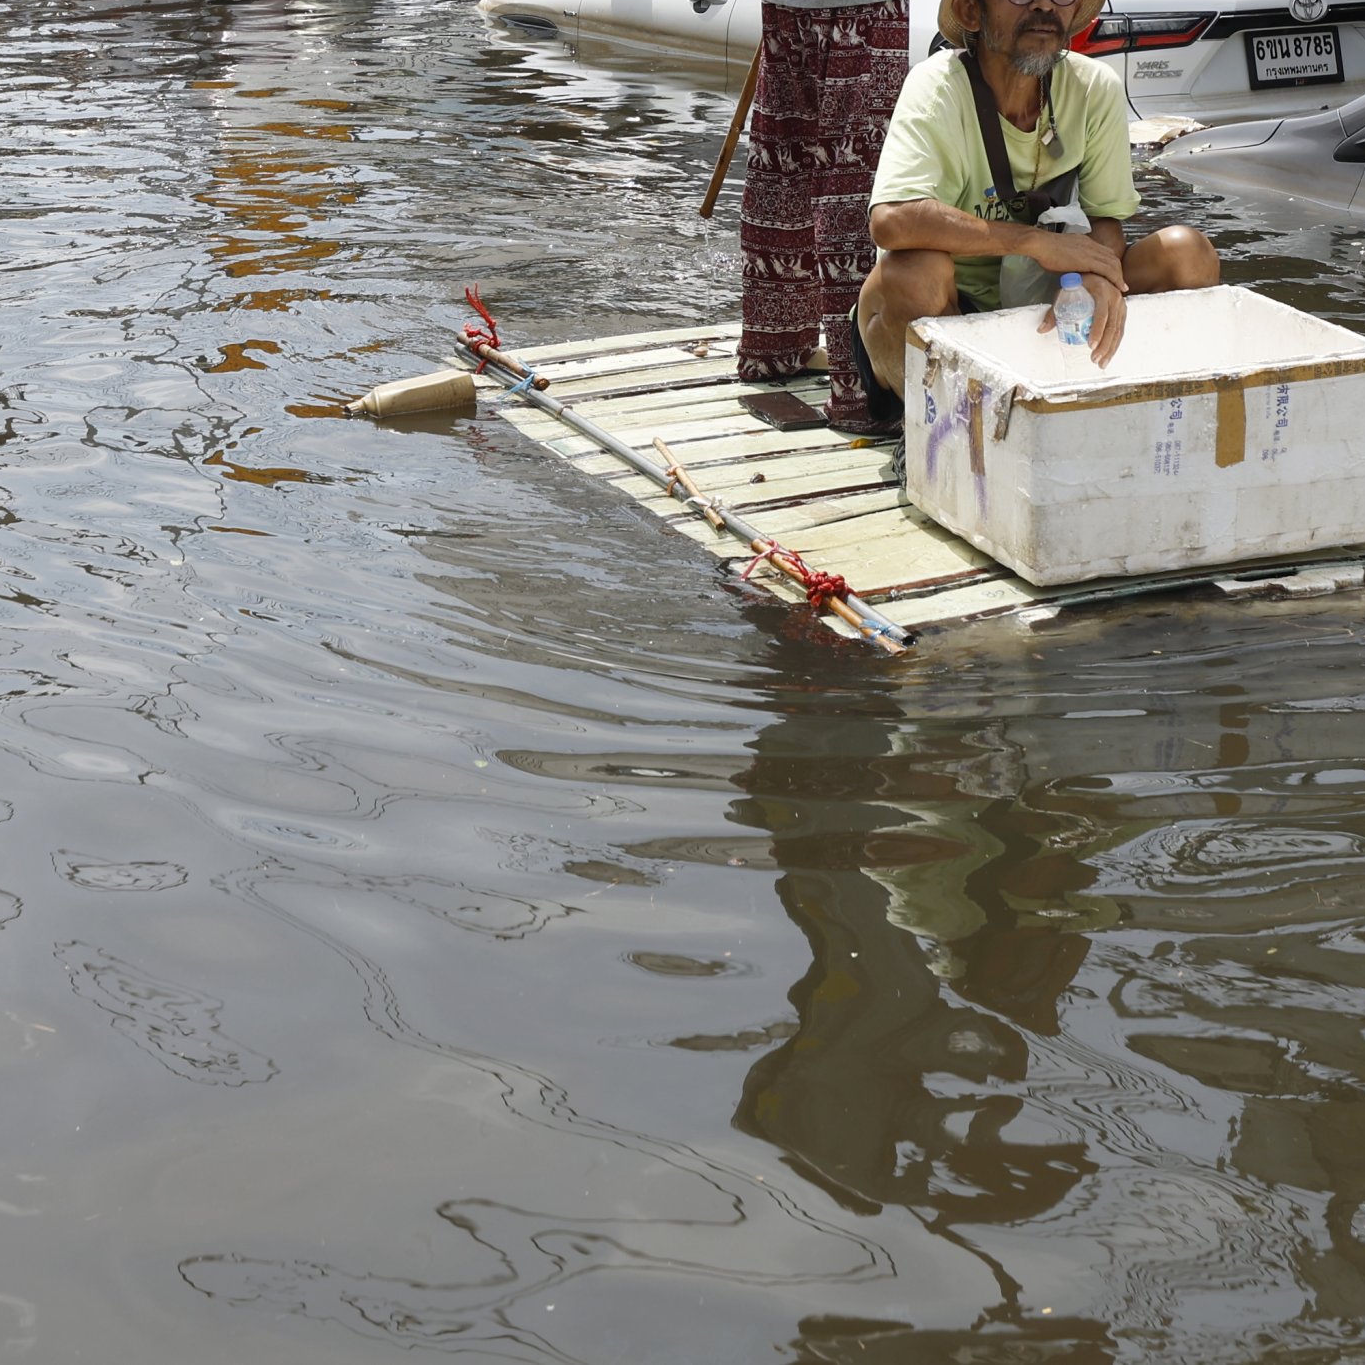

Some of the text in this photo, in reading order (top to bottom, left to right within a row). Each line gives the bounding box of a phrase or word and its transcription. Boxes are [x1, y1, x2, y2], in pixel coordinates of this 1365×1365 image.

[1256, 35, 1333, 61] 6ขน 8785
[1133, 69, 1184, 79] CROSS
[1136, 60, 1170, 70] YARIS
[1265, 62, 1329, 80] กรุงเทพมหานคร
[1169, 398, 1183, 420] 公司
[1275, 384, 1291, 429] 有限公司
